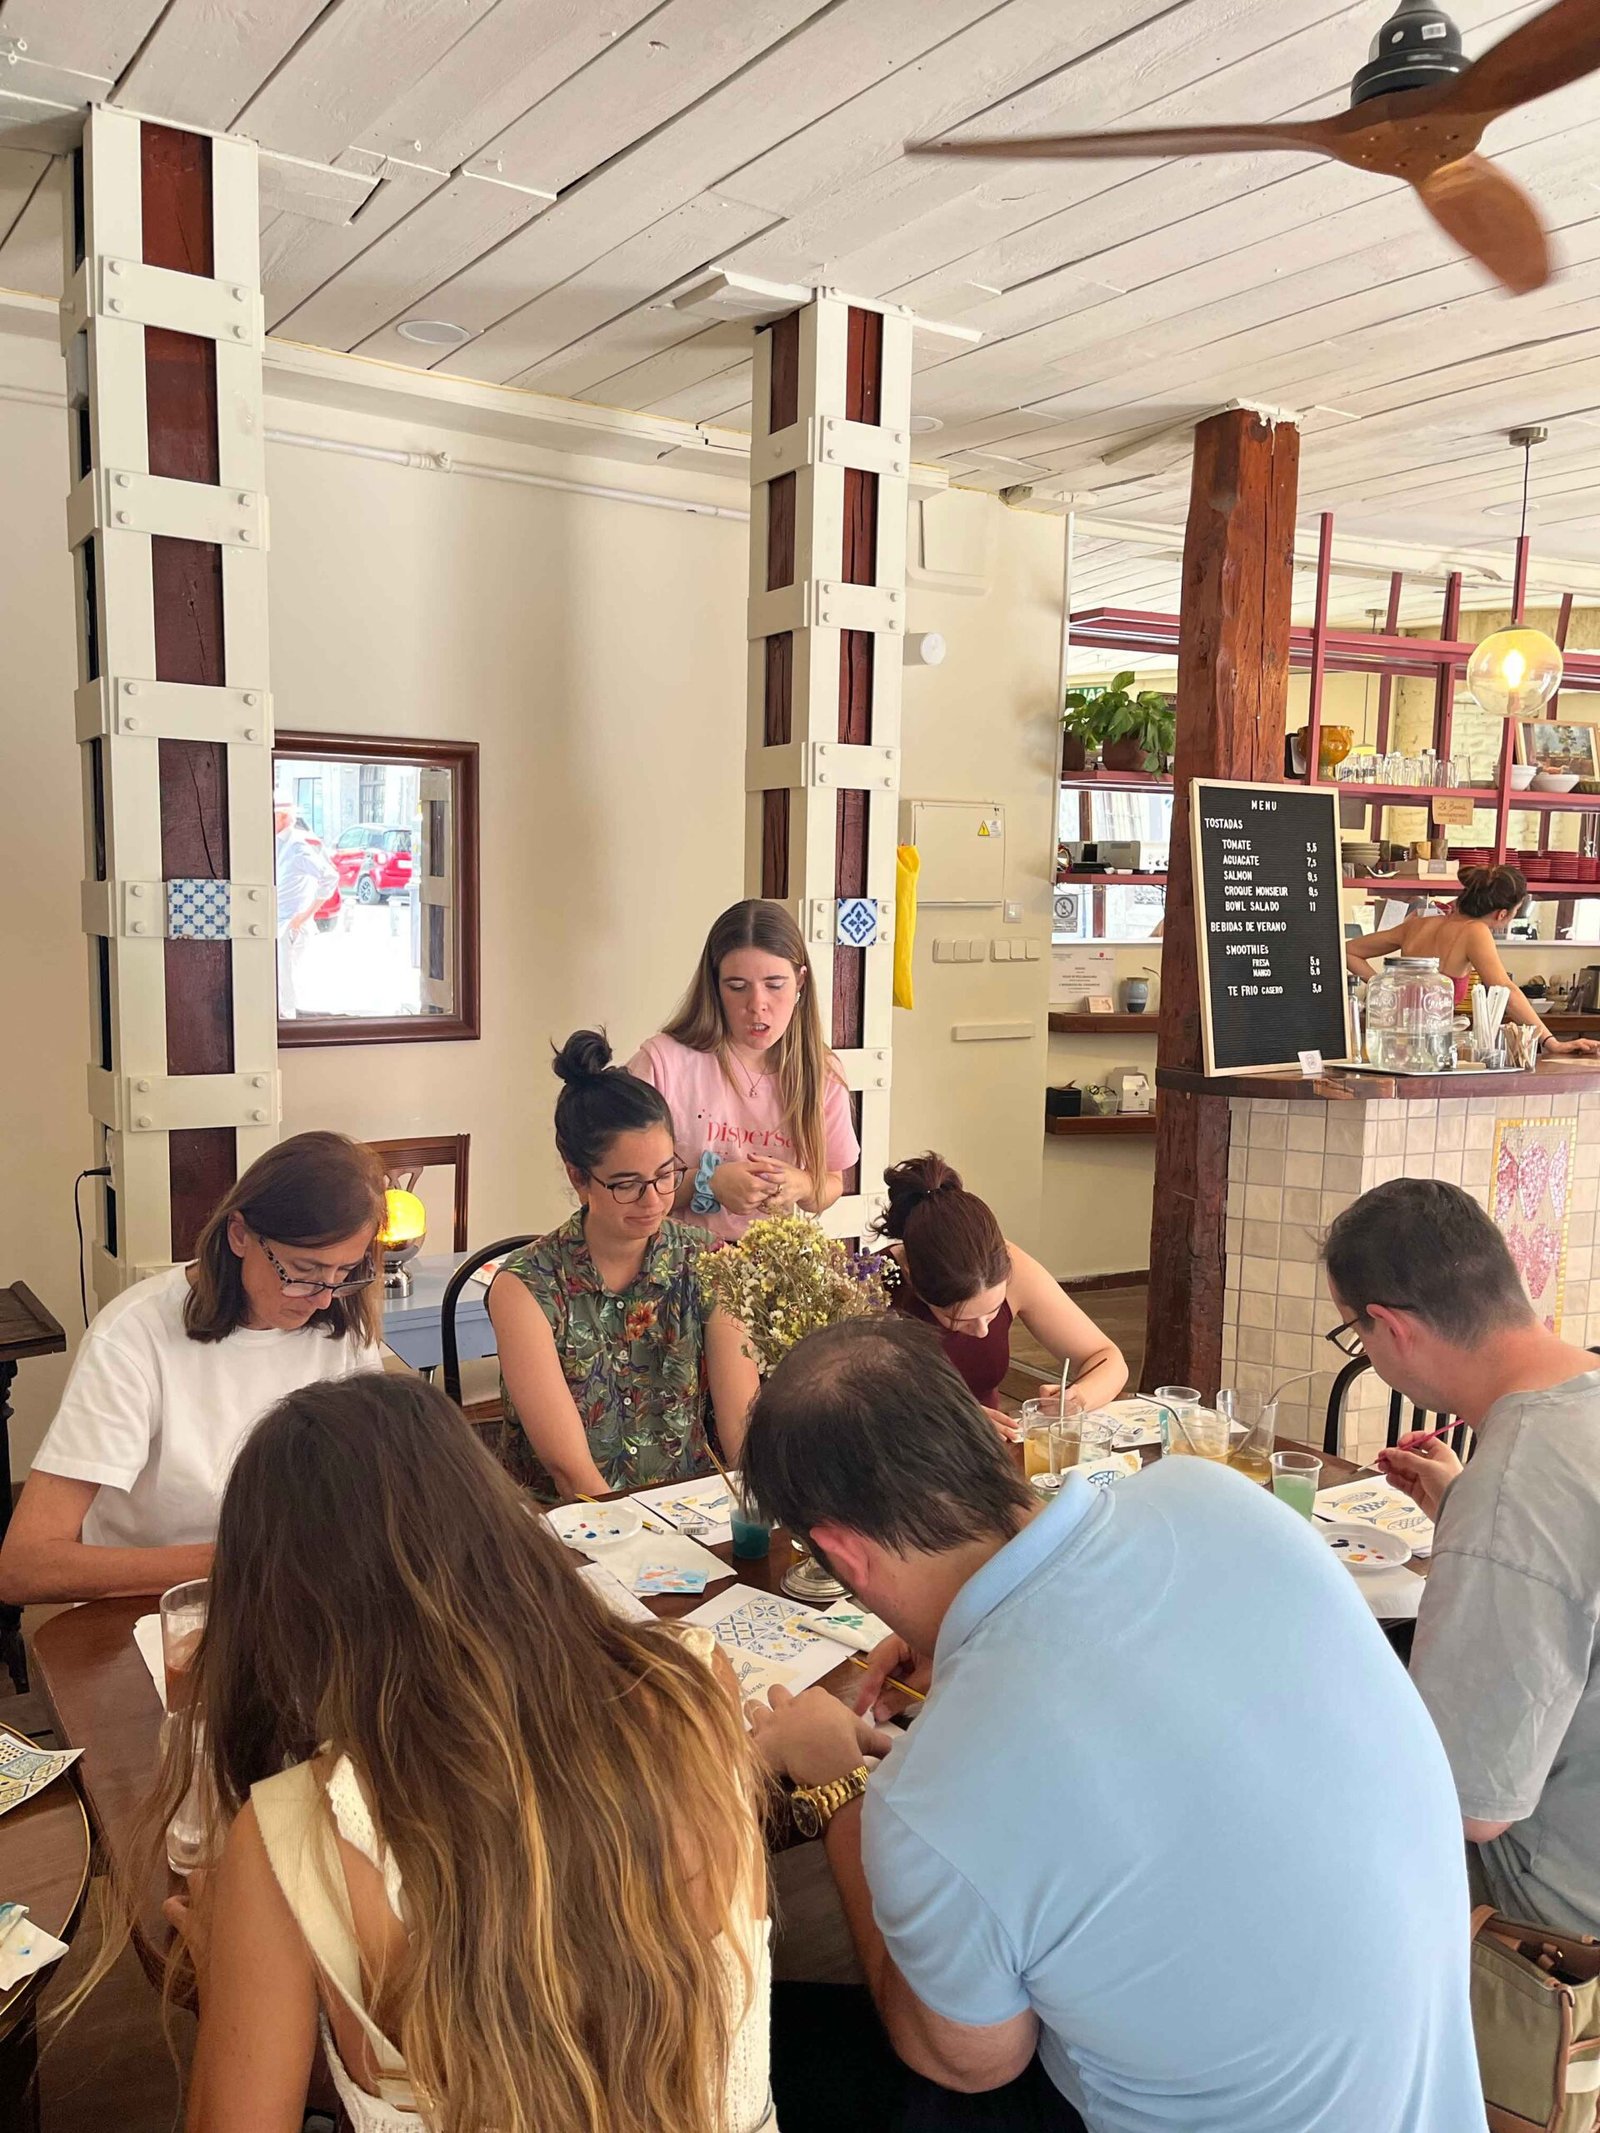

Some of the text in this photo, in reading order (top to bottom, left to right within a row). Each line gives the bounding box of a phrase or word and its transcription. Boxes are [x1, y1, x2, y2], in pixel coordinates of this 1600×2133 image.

[1251, 799, 1277, 811] MENU
[1203, 817, 1244, 830] TOSTADAS
[1221, 838, 1252, 851] TOMATE
[1222, 854, 1260, 867] AGUACATE
[1223, 870, 1253, 881] SALMON
[1224, 885, 1254, 897] CROQUE
[1255, 885, 1289, 897] MONSIEUR
[1224, 900, 1316, 912] BOWL SALADO 11
[1210, 921, 1287, 933] BEBIDAS DE VERANO
[1251, 957, 1271, 968] FRESA
[1227, 985, 1239, 997] TE
[1240, 985, 1259, 997] FRIO
